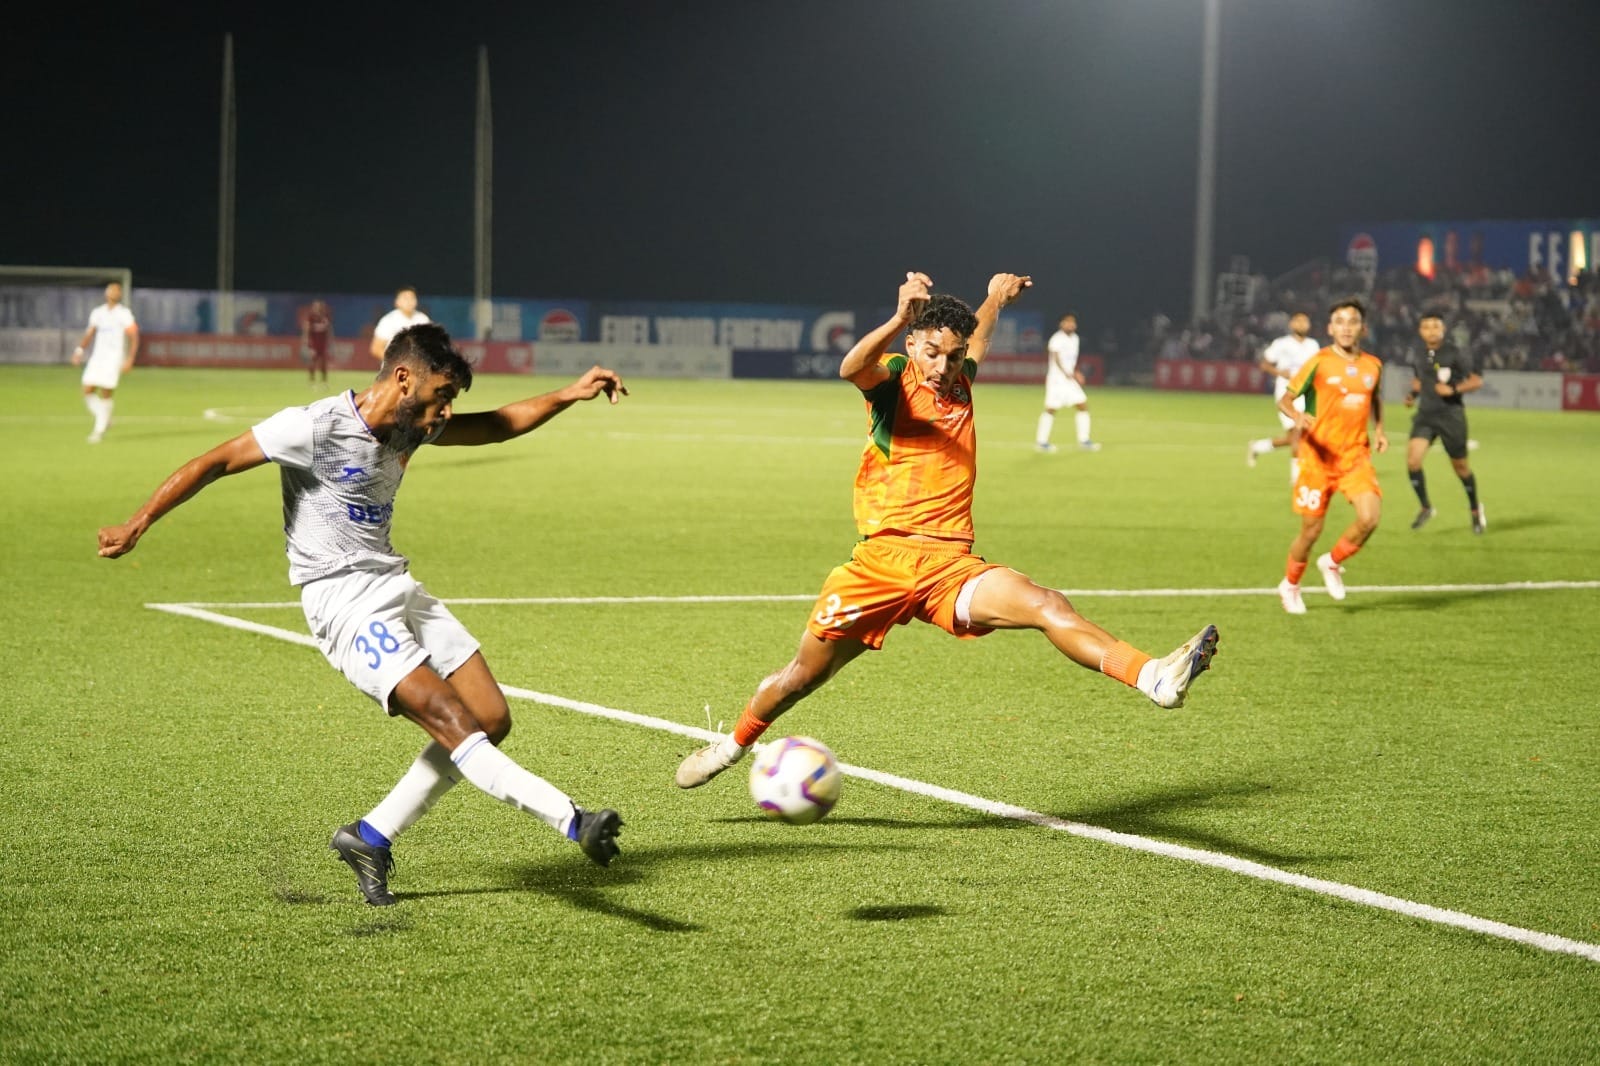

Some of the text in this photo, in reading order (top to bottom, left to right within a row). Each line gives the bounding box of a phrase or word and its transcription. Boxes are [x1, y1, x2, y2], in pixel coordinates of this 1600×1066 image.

[656, 317, 714, 346] YOUR
[719, 318, 803, 349] ENERGY
[1296, 486, 1321, 510] 36
[355, 621, 400, 670] 38
